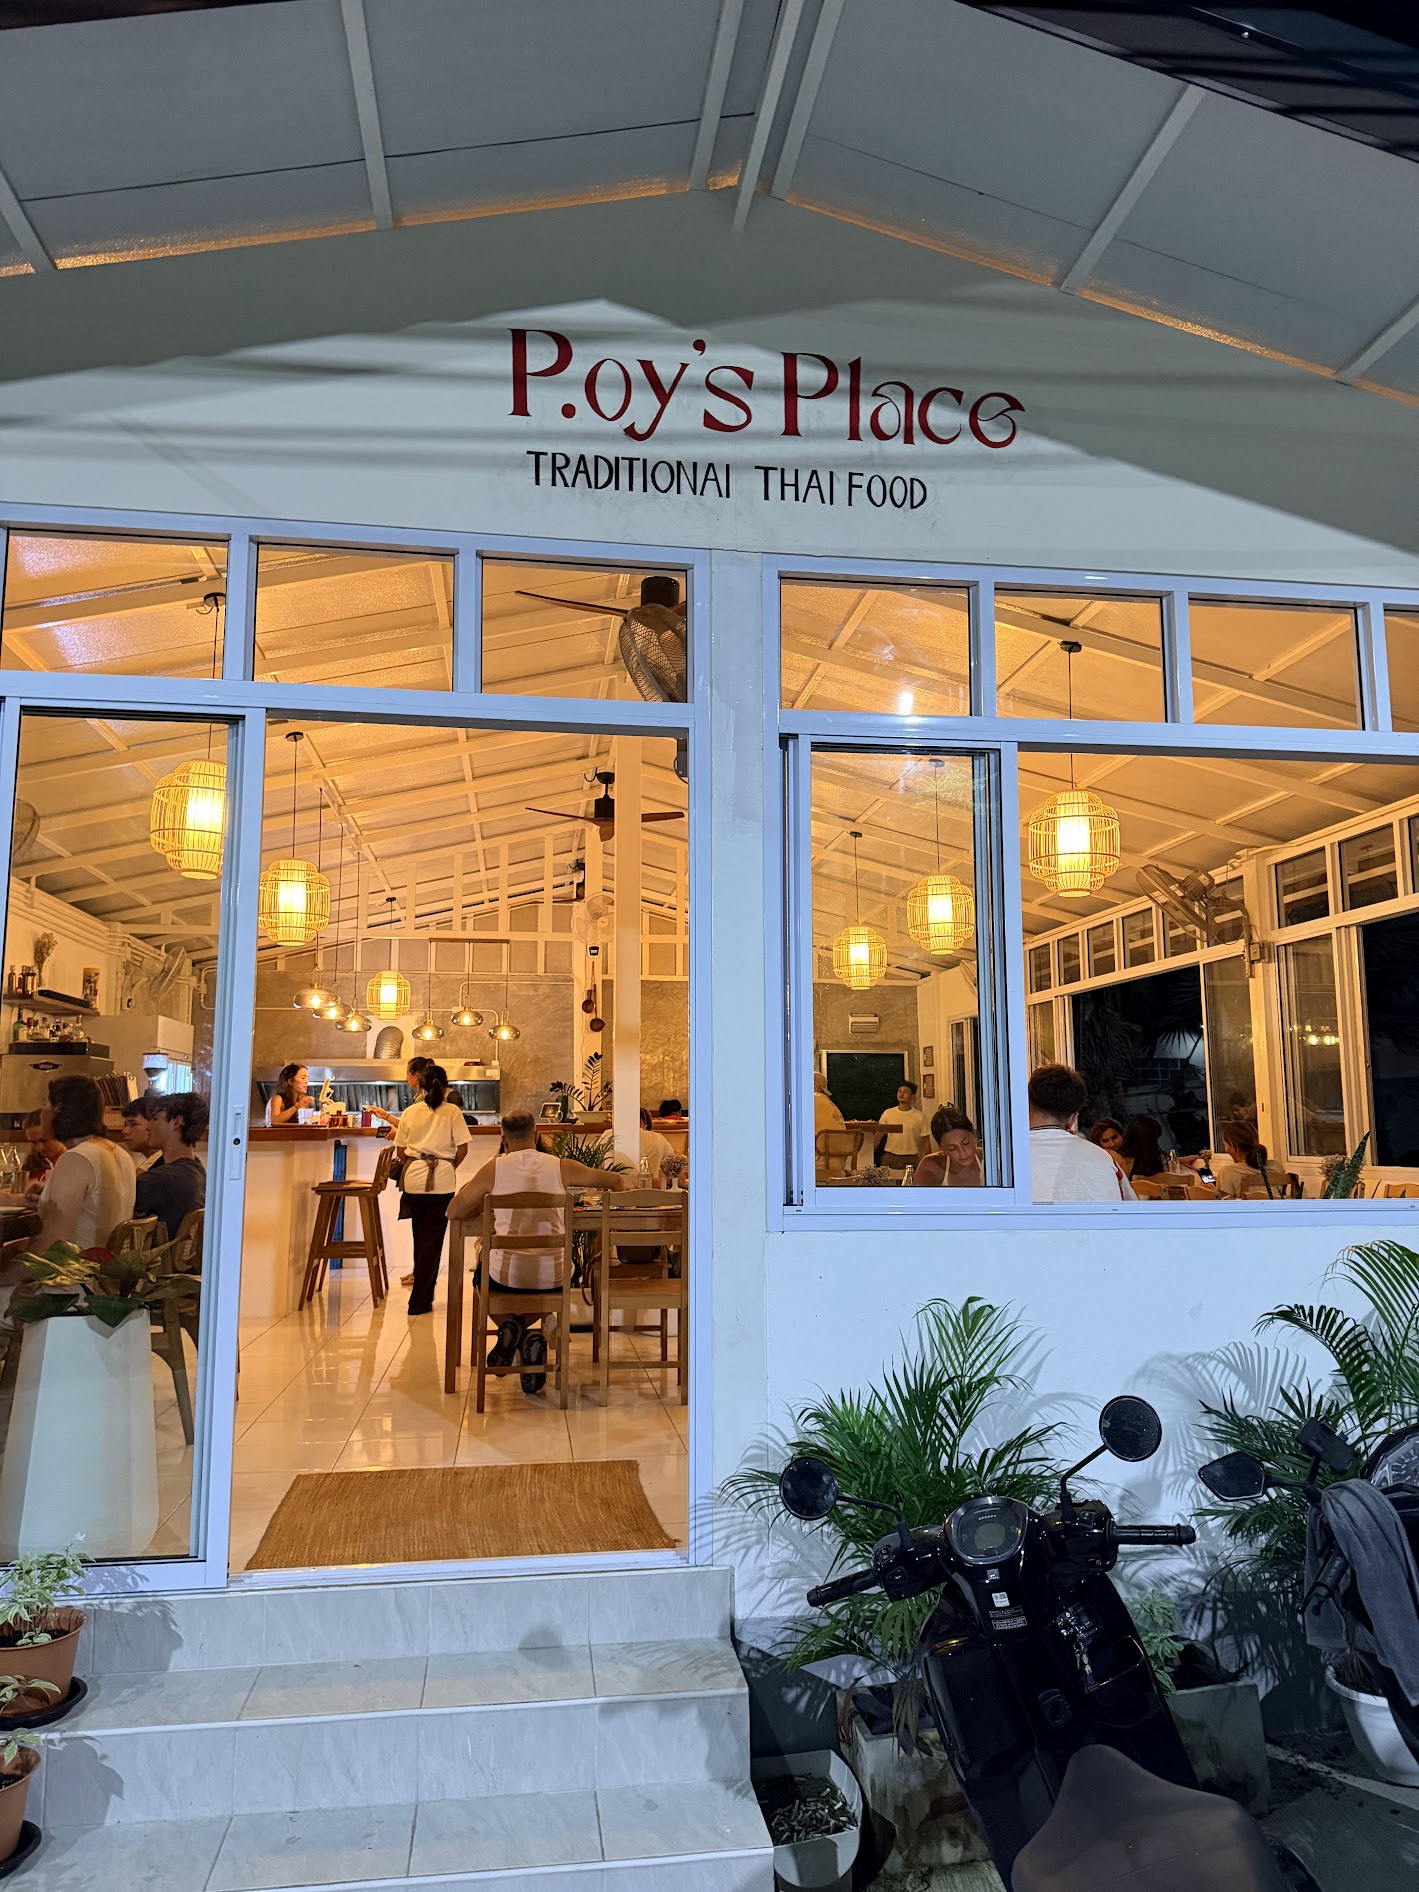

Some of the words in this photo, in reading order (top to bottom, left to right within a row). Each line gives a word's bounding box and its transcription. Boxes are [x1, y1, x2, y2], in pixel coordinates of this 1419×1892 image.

[781, 351, 1026, 449] Place
[754, 465, 834, 506] THAI
[847, 471, 927, 510] FOOD
